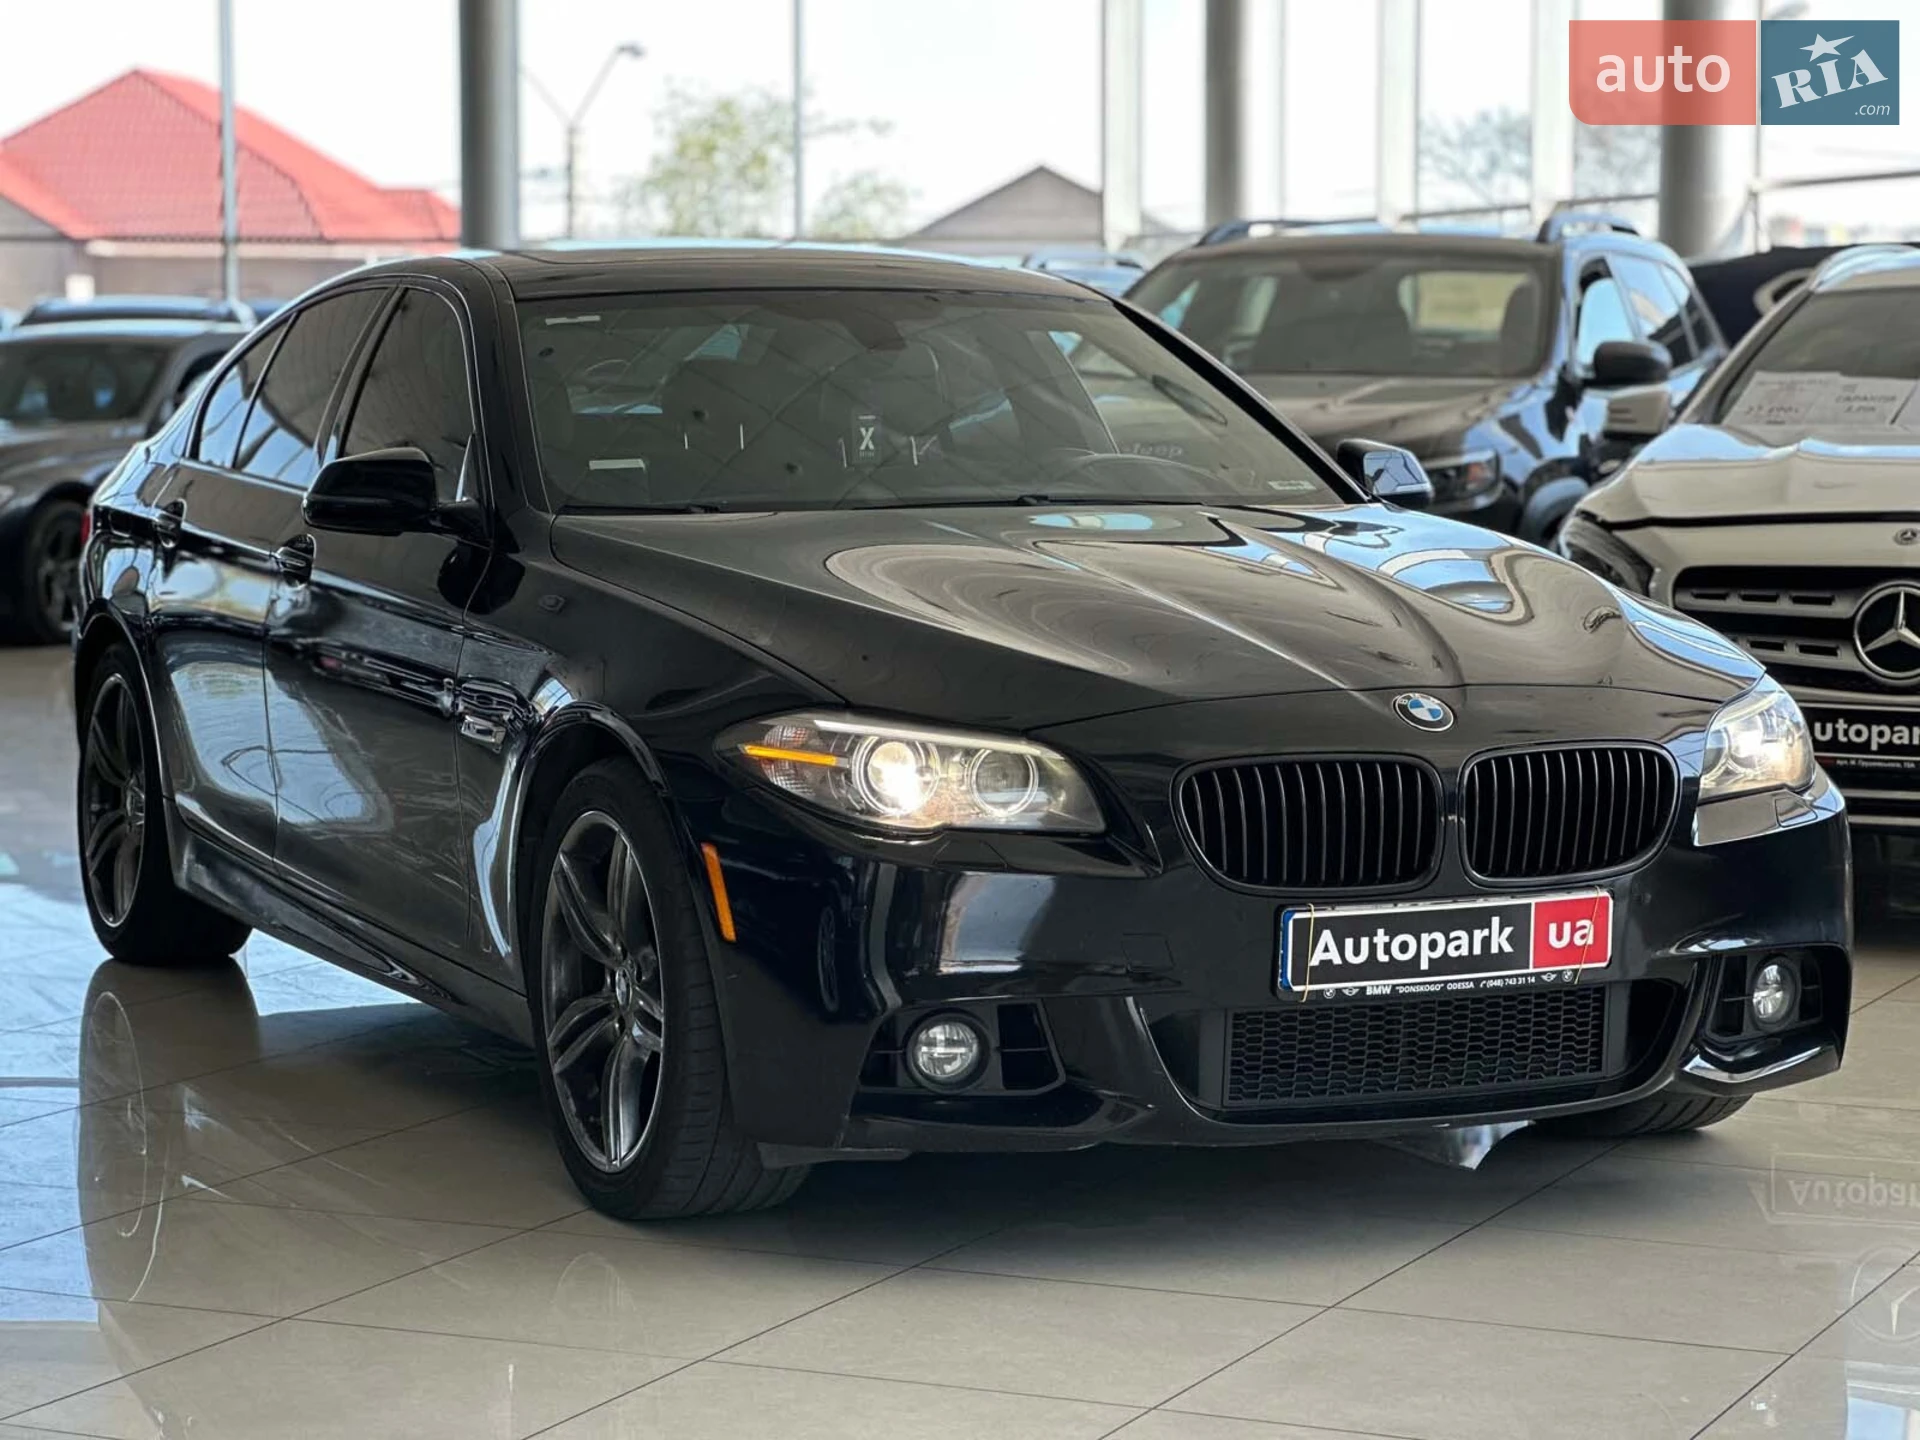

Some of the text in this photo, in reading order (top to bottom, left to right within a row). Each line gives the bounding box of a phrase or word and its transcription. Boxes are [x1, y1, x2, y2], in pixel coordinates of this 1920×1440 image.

[1814, 718, 1920, 751] utopar
[1309, 916, 1595, 970] Autopark ua
[1366, 984, 1392, 996] BMW
[1446, 981, 1475, 991] ODESSA
[1505, 976, 1517, 986] 743
[1527, 975, 1536, 984] 14
